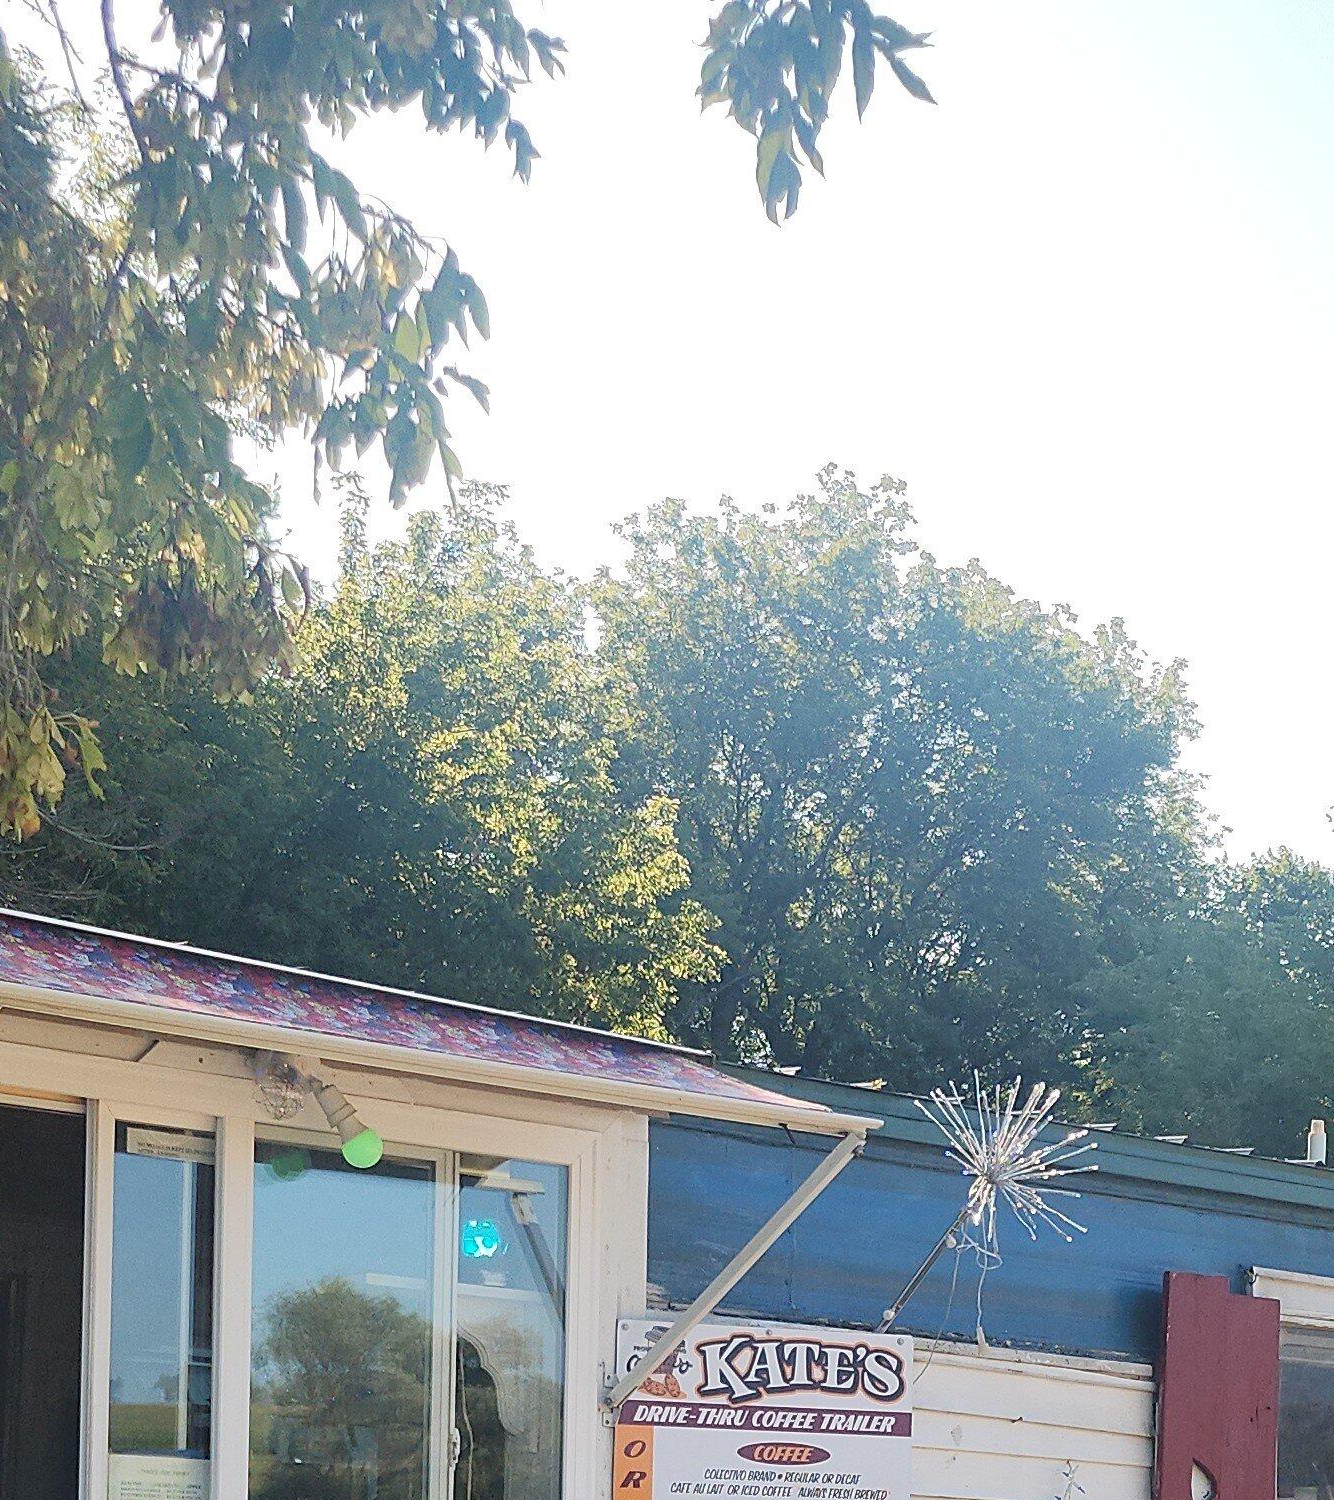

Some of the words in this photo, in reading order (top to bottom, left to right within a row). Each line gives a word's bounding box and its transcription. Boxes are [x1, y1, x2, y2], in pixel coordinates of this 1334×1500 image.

[697, 1333, 904, 1404] KATE'S
[633, 1405, 749, 1427] DRIVE-THRU
[752, 1410, 815, 1430] COFFEE
[821, 1413, 896, 1433] TRAILER
[753, 1445, 814, 1462] COFFEE
[704, 1468, 746, 1480] COLECTIVO
[748, 1470, 777, 1482] BRAND
[784, 1472, 820, 1484] REGULAR
[822, 1473, 833, 1484] OR
[835, 1474, 861, 1484] DECAF
[671, 1483, 692, 1494] CAFE
[693, 1483, 705, 1494] AU
[706, 1484, 725, 1495] LAIT
[727, 1484, 739, 1495] OR
[741, 1485, 760, 1496] ICED
[761, 1486, 792, 1497] COFFEE
[798, 1488, 827, 1499] ALWAYS
[828, 1489, 853, 1500] FRESH
